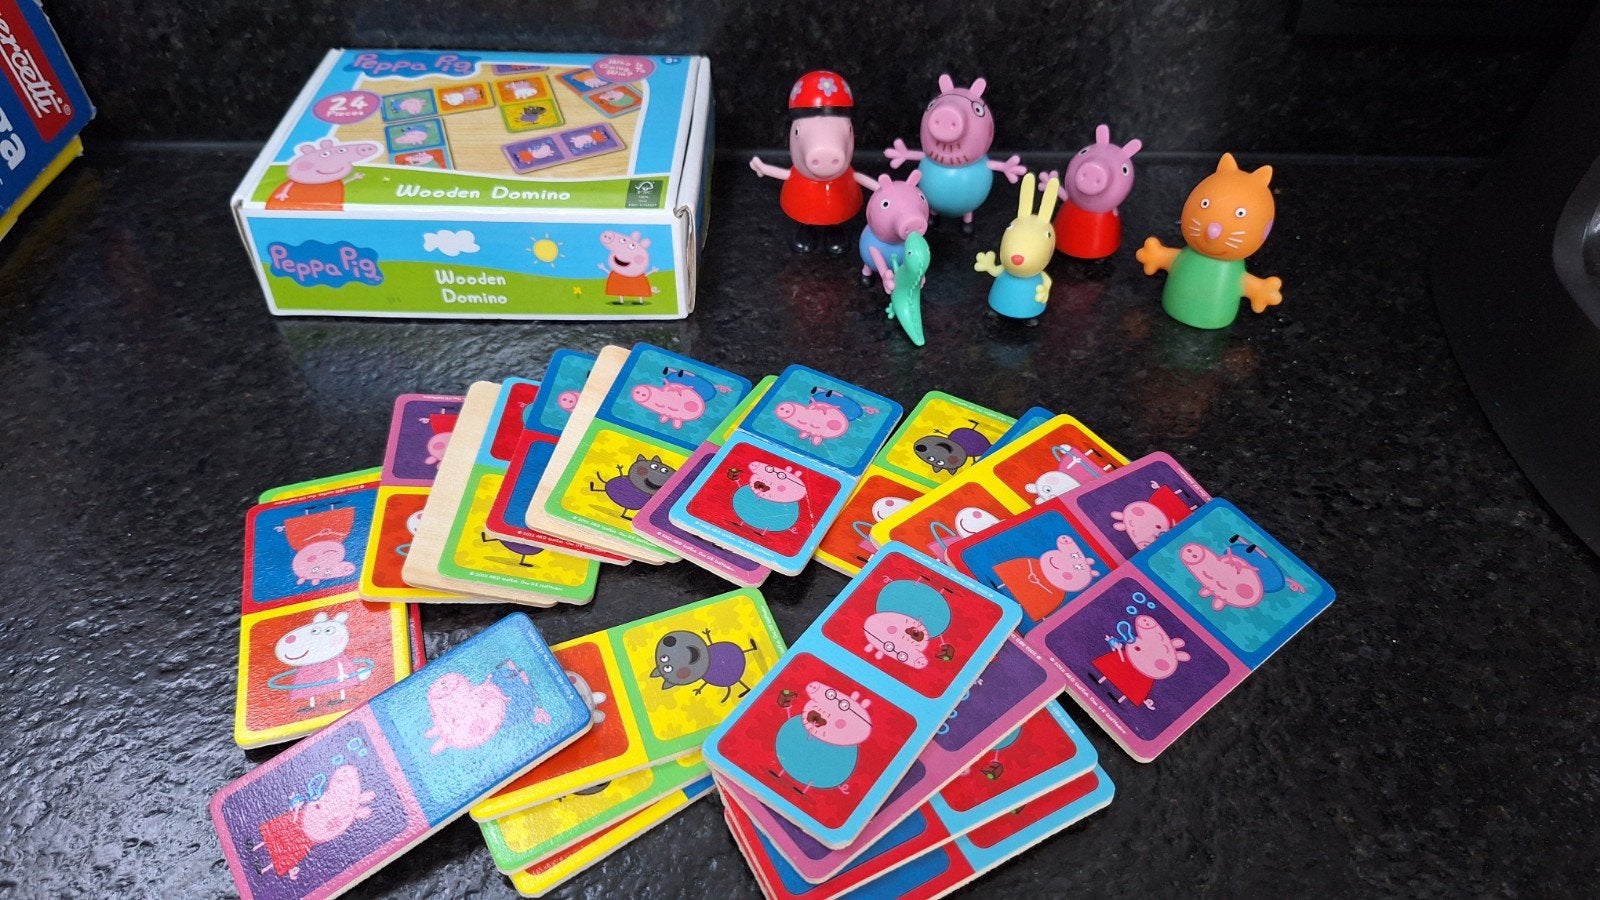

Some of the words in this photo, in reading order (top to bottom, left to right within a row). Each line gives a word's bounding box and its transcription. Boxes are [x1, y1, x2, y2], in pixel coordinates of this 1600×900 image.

[353, 53, 428, 75] Peppa
[435, 54, 472, 74] Pig
[329, 95, 369, 111] 24
[326, 110, 364, 118] Pieces
[396, 184, 481, 199] Wooden
[491, 185, 571, 201] Domino
[269, 244, 343, 282] Peppa
[340, 246, 383, 280] Pig
[434, 269, 507, 287] Wooden
[441, 288, 508, 305] Domino
